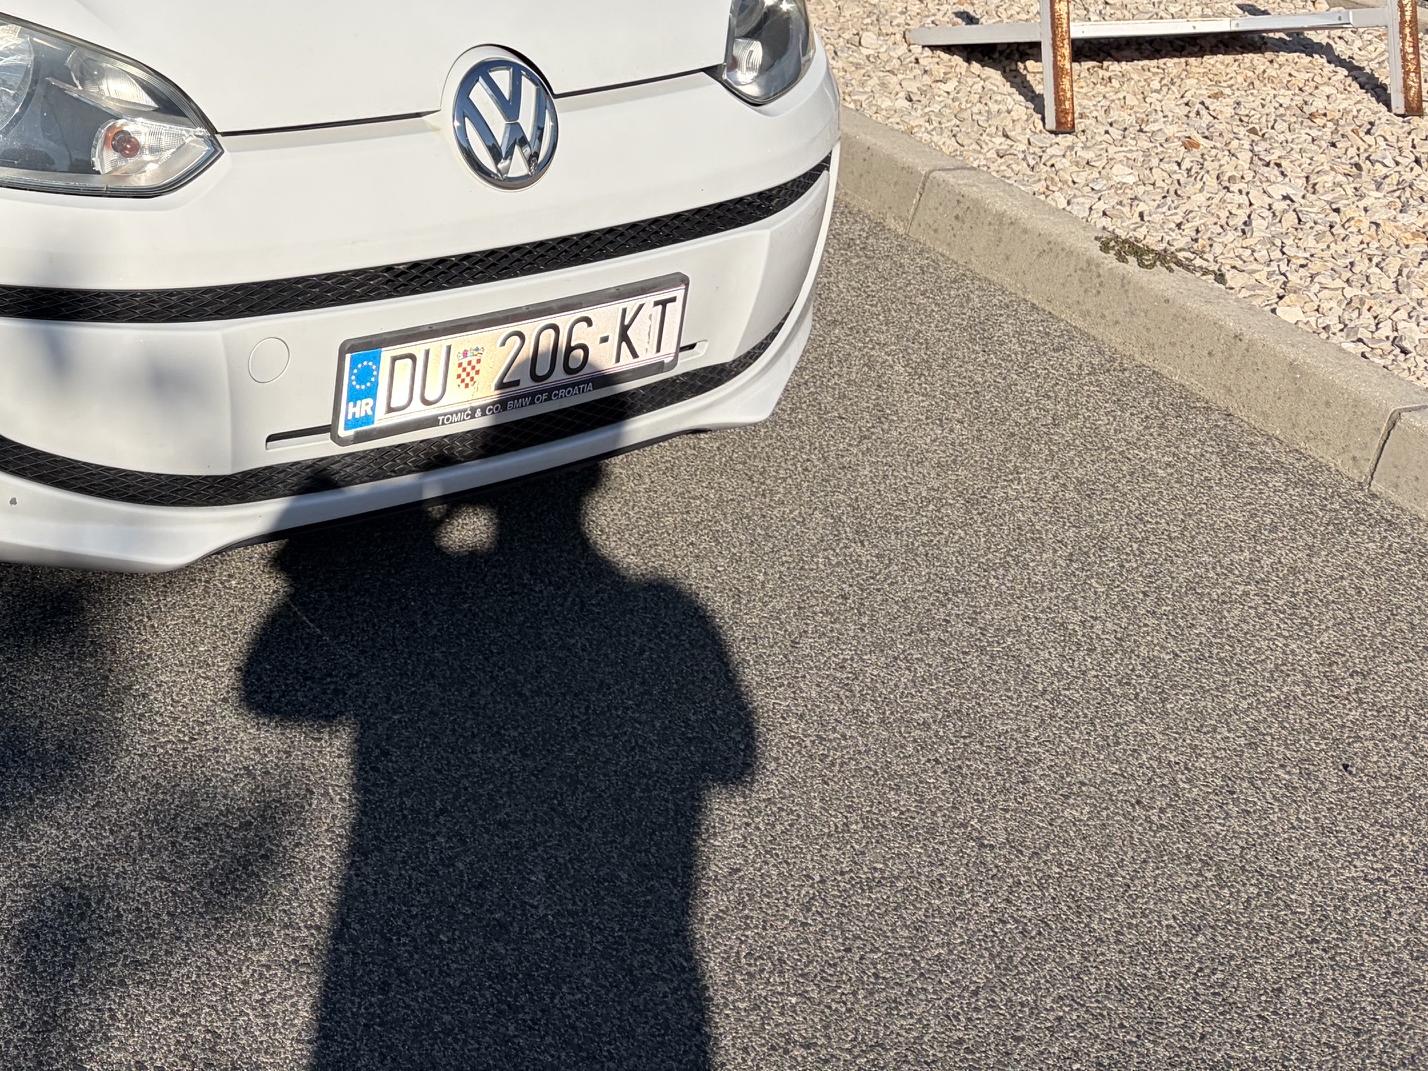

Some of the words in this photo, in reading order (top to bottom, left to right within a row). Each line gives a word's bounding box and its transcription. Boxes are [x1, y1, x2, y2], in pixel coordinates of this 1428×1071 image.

[384, 344, 451, 415] DU
[493, 295, 677, 392] 206-KT
[347, 397, 374, 421] HR
[437, 408, 472, 426] TOMIĆ
[474, 408, 482, 418] &
[485, 404, 503, 415] CO.
[507, 397, 532, 410] BMW
[534, 393, 548, 404] OF
[551, 382, 594, 400] CROATIA
